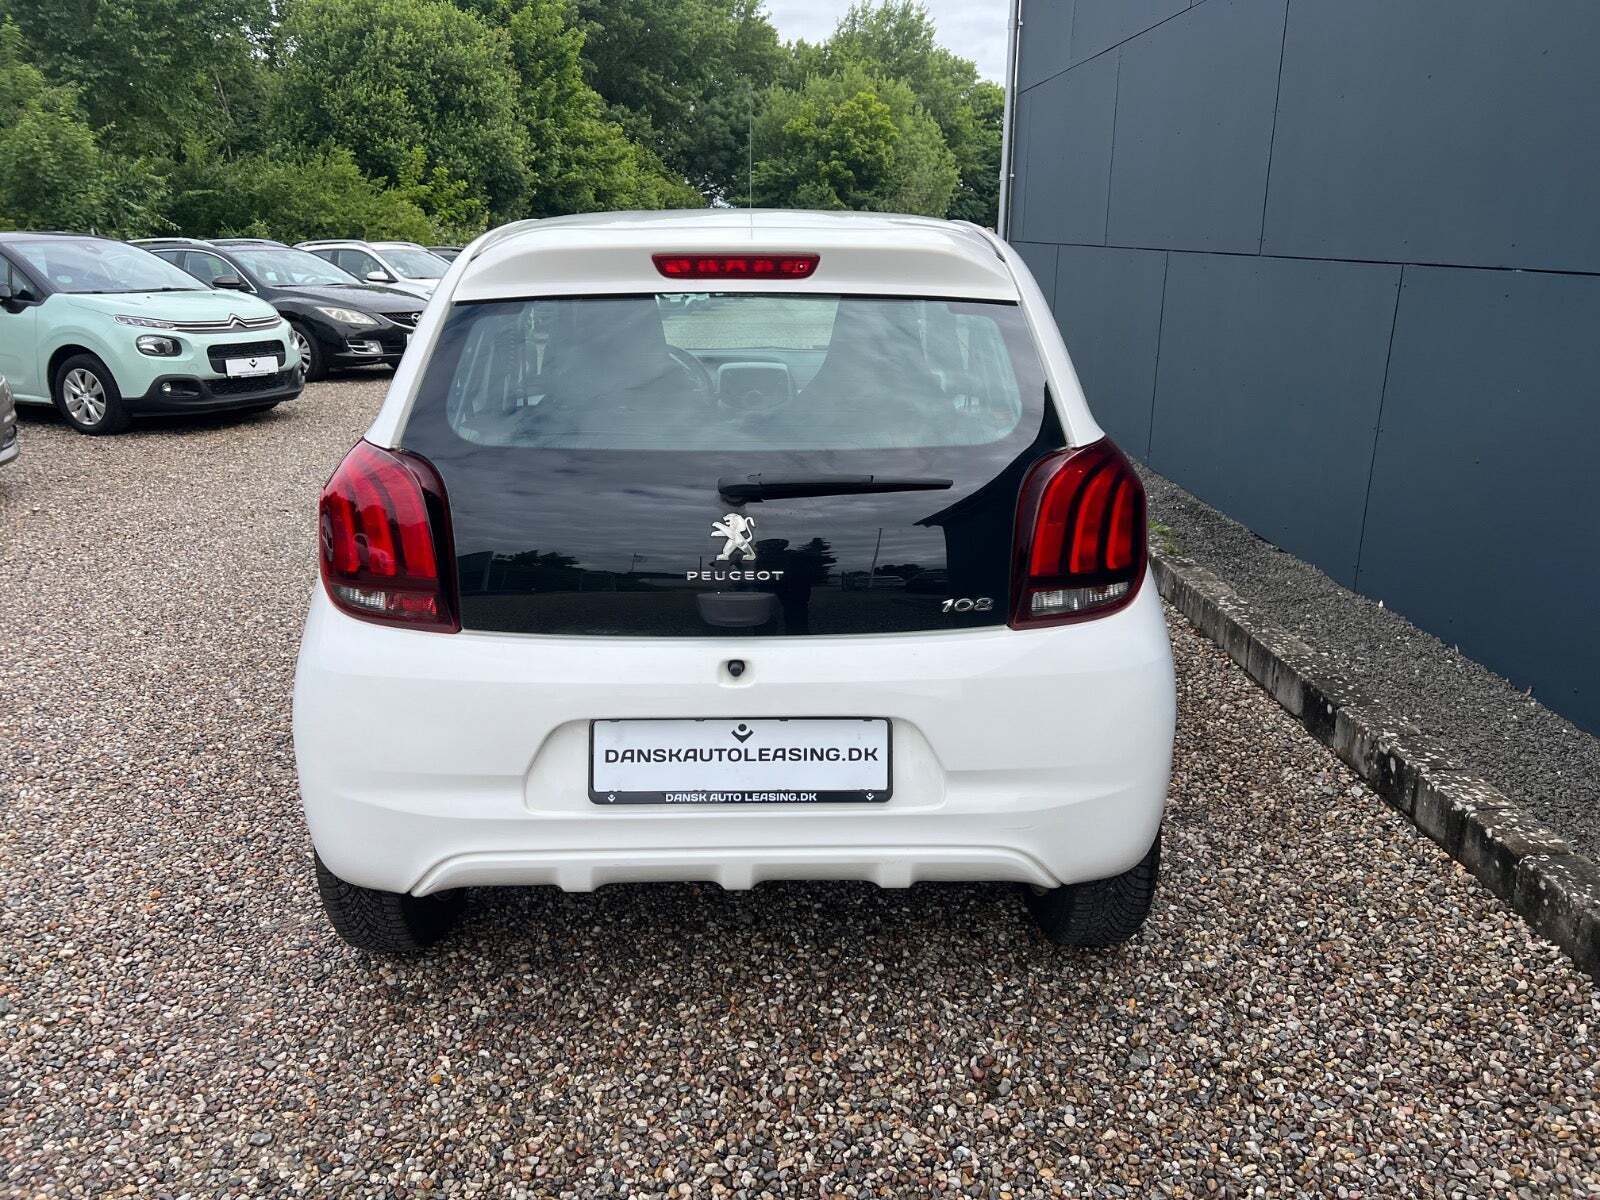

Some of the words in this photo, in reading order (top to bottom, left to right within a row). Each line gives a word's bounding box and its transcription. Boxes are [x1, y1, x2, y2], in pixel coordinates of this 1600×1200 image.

[686, 571, 784, 581] PEUGEOT
[941, 598, 995, 612] 108
[604, 747, 879, 763] DANSKAUTOLEASING.DK
[665, 793, 707, 802] DANSK
[709, 793, 741, 802] AUTO
[744, 792, 817, 801] LEASING.DK
